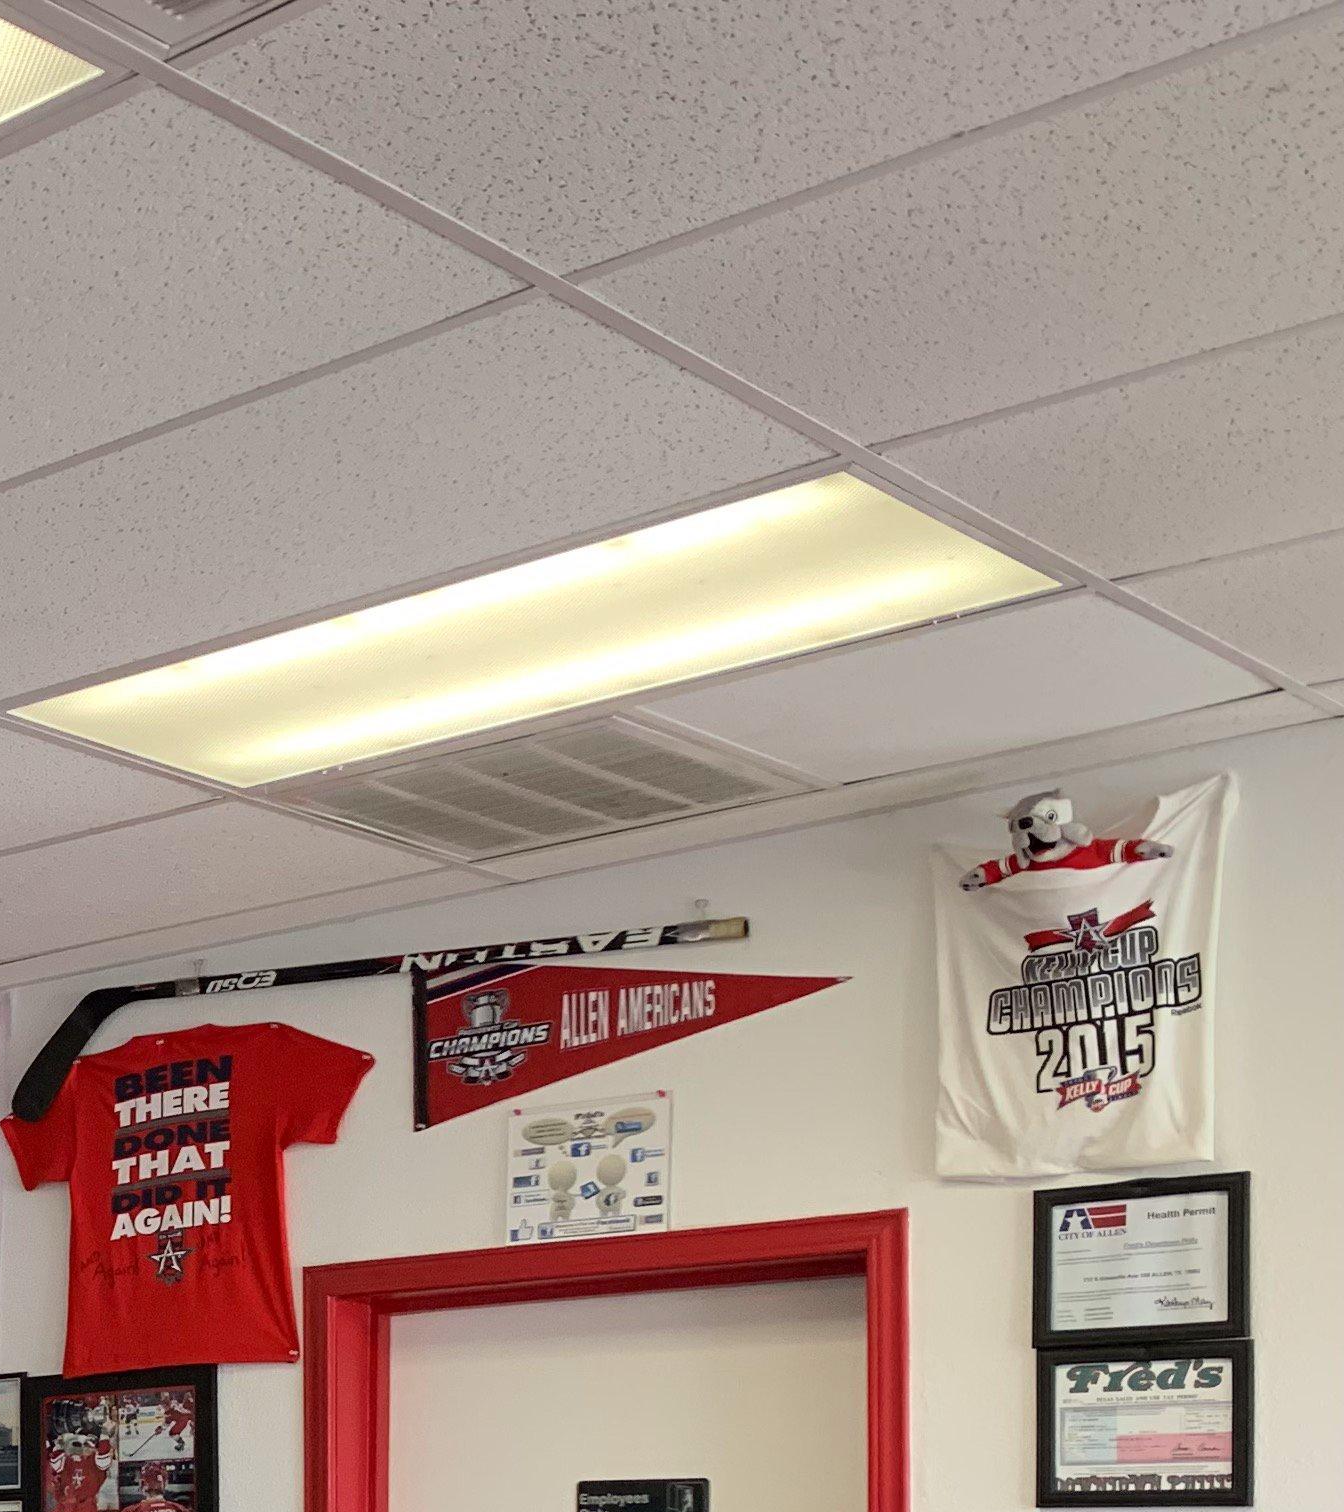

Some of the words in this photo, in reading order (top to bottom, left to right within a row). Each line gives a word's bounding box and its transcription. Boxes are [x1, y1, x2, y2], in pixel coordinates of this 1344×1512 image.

[1100, 928, 1157, 971] CUP
[561, 990, 610, 1050] ALLEN
[617, 980, 716, 1036] AMERICANS
[989, 956, 1200, 1033] CHAMPIONS
[429, 1024, 550, 1058] CHAMPIONS
[1036, 1013, 1156, 1093] 2015
[114, 1054, 233, 1100] BEEN
[1065, 1080, 1099, 1102] KELLY
[1108, 1078, 1132, 1095] CUP
[114, 1082, 230, 1128] THERE
[113, 1118, 231, 1159] DONE
[113, 1140, 231, 1186] THAT
[112, 1184, 182, 1214] DID
[196, 1176, 232, 1201] IT
[1147, 1210, 1180, 1220] Health
[1183, 1207, 1216, 1217] Permit
[110, 1195, 232, 1241] AGAIN!
[1058, 1232, 1079, 1241] CITY
[1082, 1231, 1094, 1239] OF
[1097, 1228, 1127, 1238] ALLEN
[1066, 1359, 1224, 1394] Fred's
[580, 1493, 649, 1507] Employees
